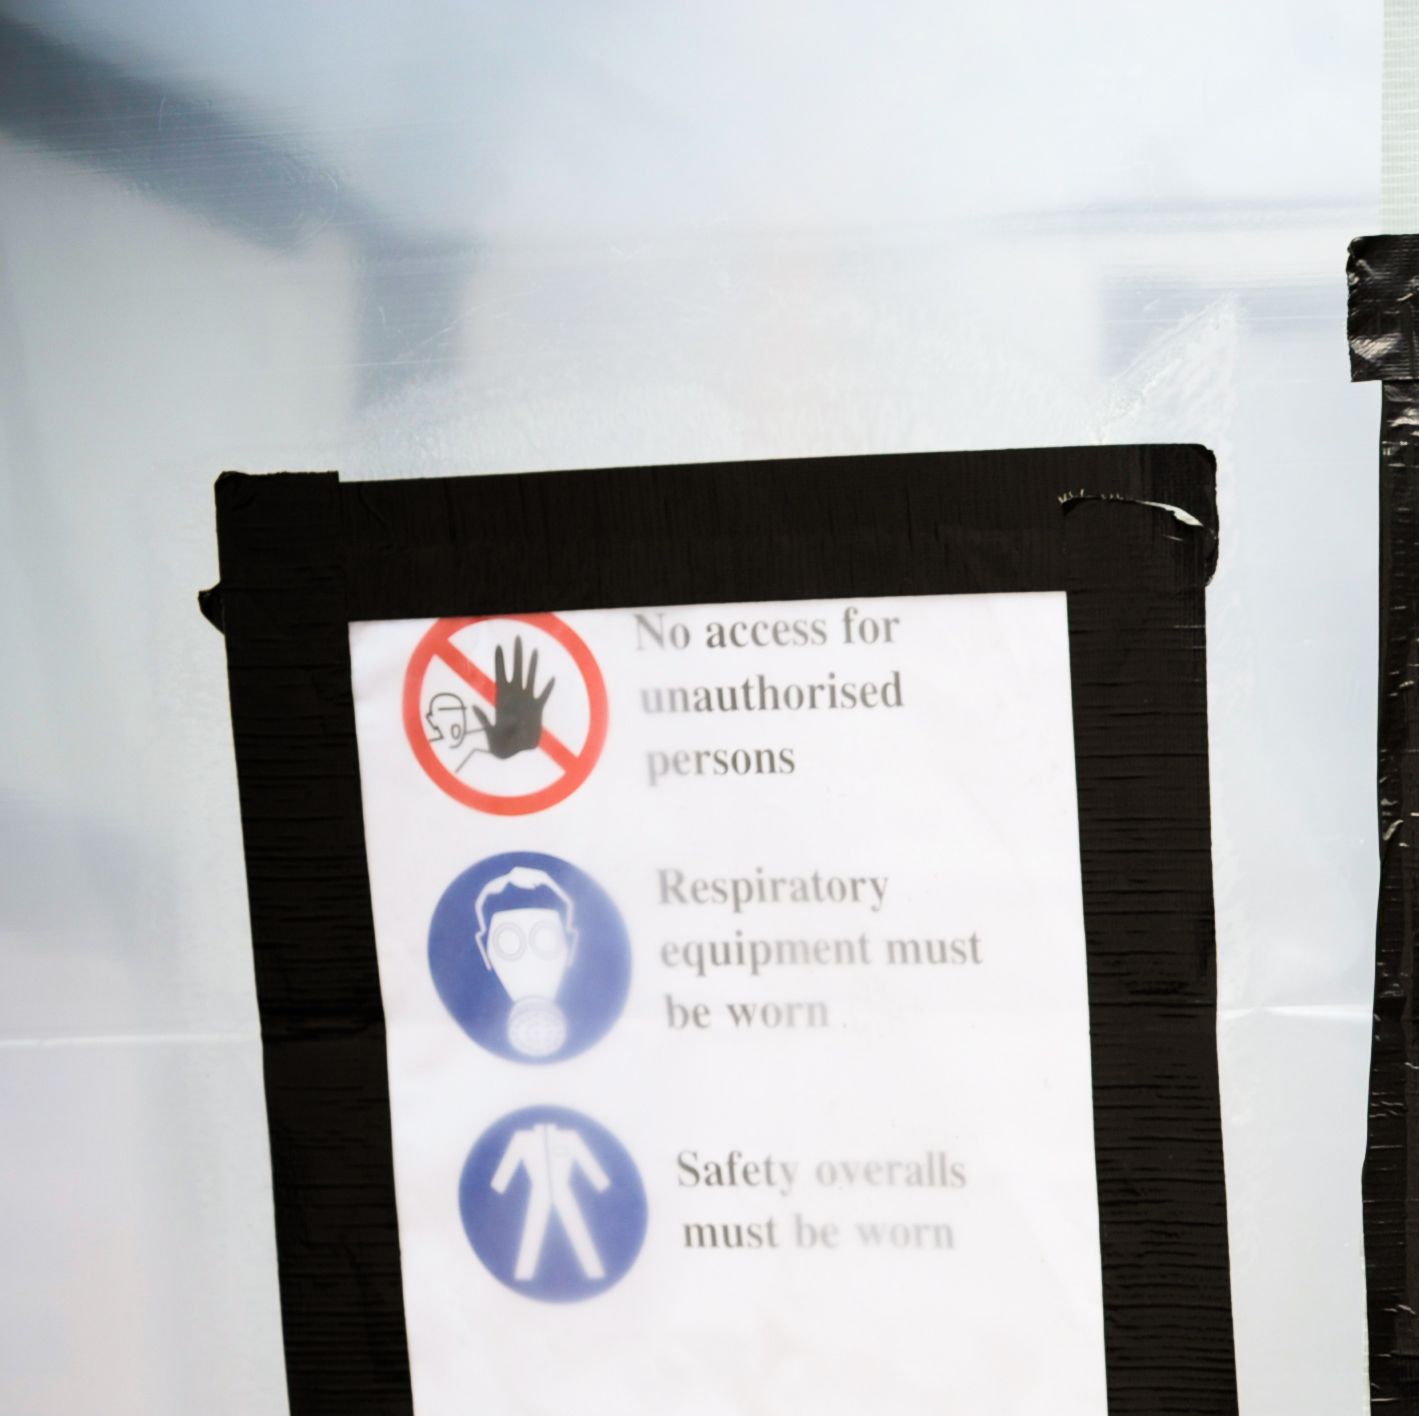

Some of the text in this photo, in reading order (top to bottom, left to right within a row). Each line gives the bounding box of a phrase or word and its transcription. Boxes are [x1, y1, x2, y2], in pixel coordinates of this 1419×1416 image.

[635, 607, 901, 653] No access for
[641, 671, 904, 714] unauthorised
[647, 744, 796, 787] persons
[658, 867, 889, 912] Respiratory
[660, 930, 983, 975] equipment must
[666, 994, 829, 1030] be worn
[677, 1149, 967, 1197] Safety overalls
[683, 1215, 955, 1251] must be worn
